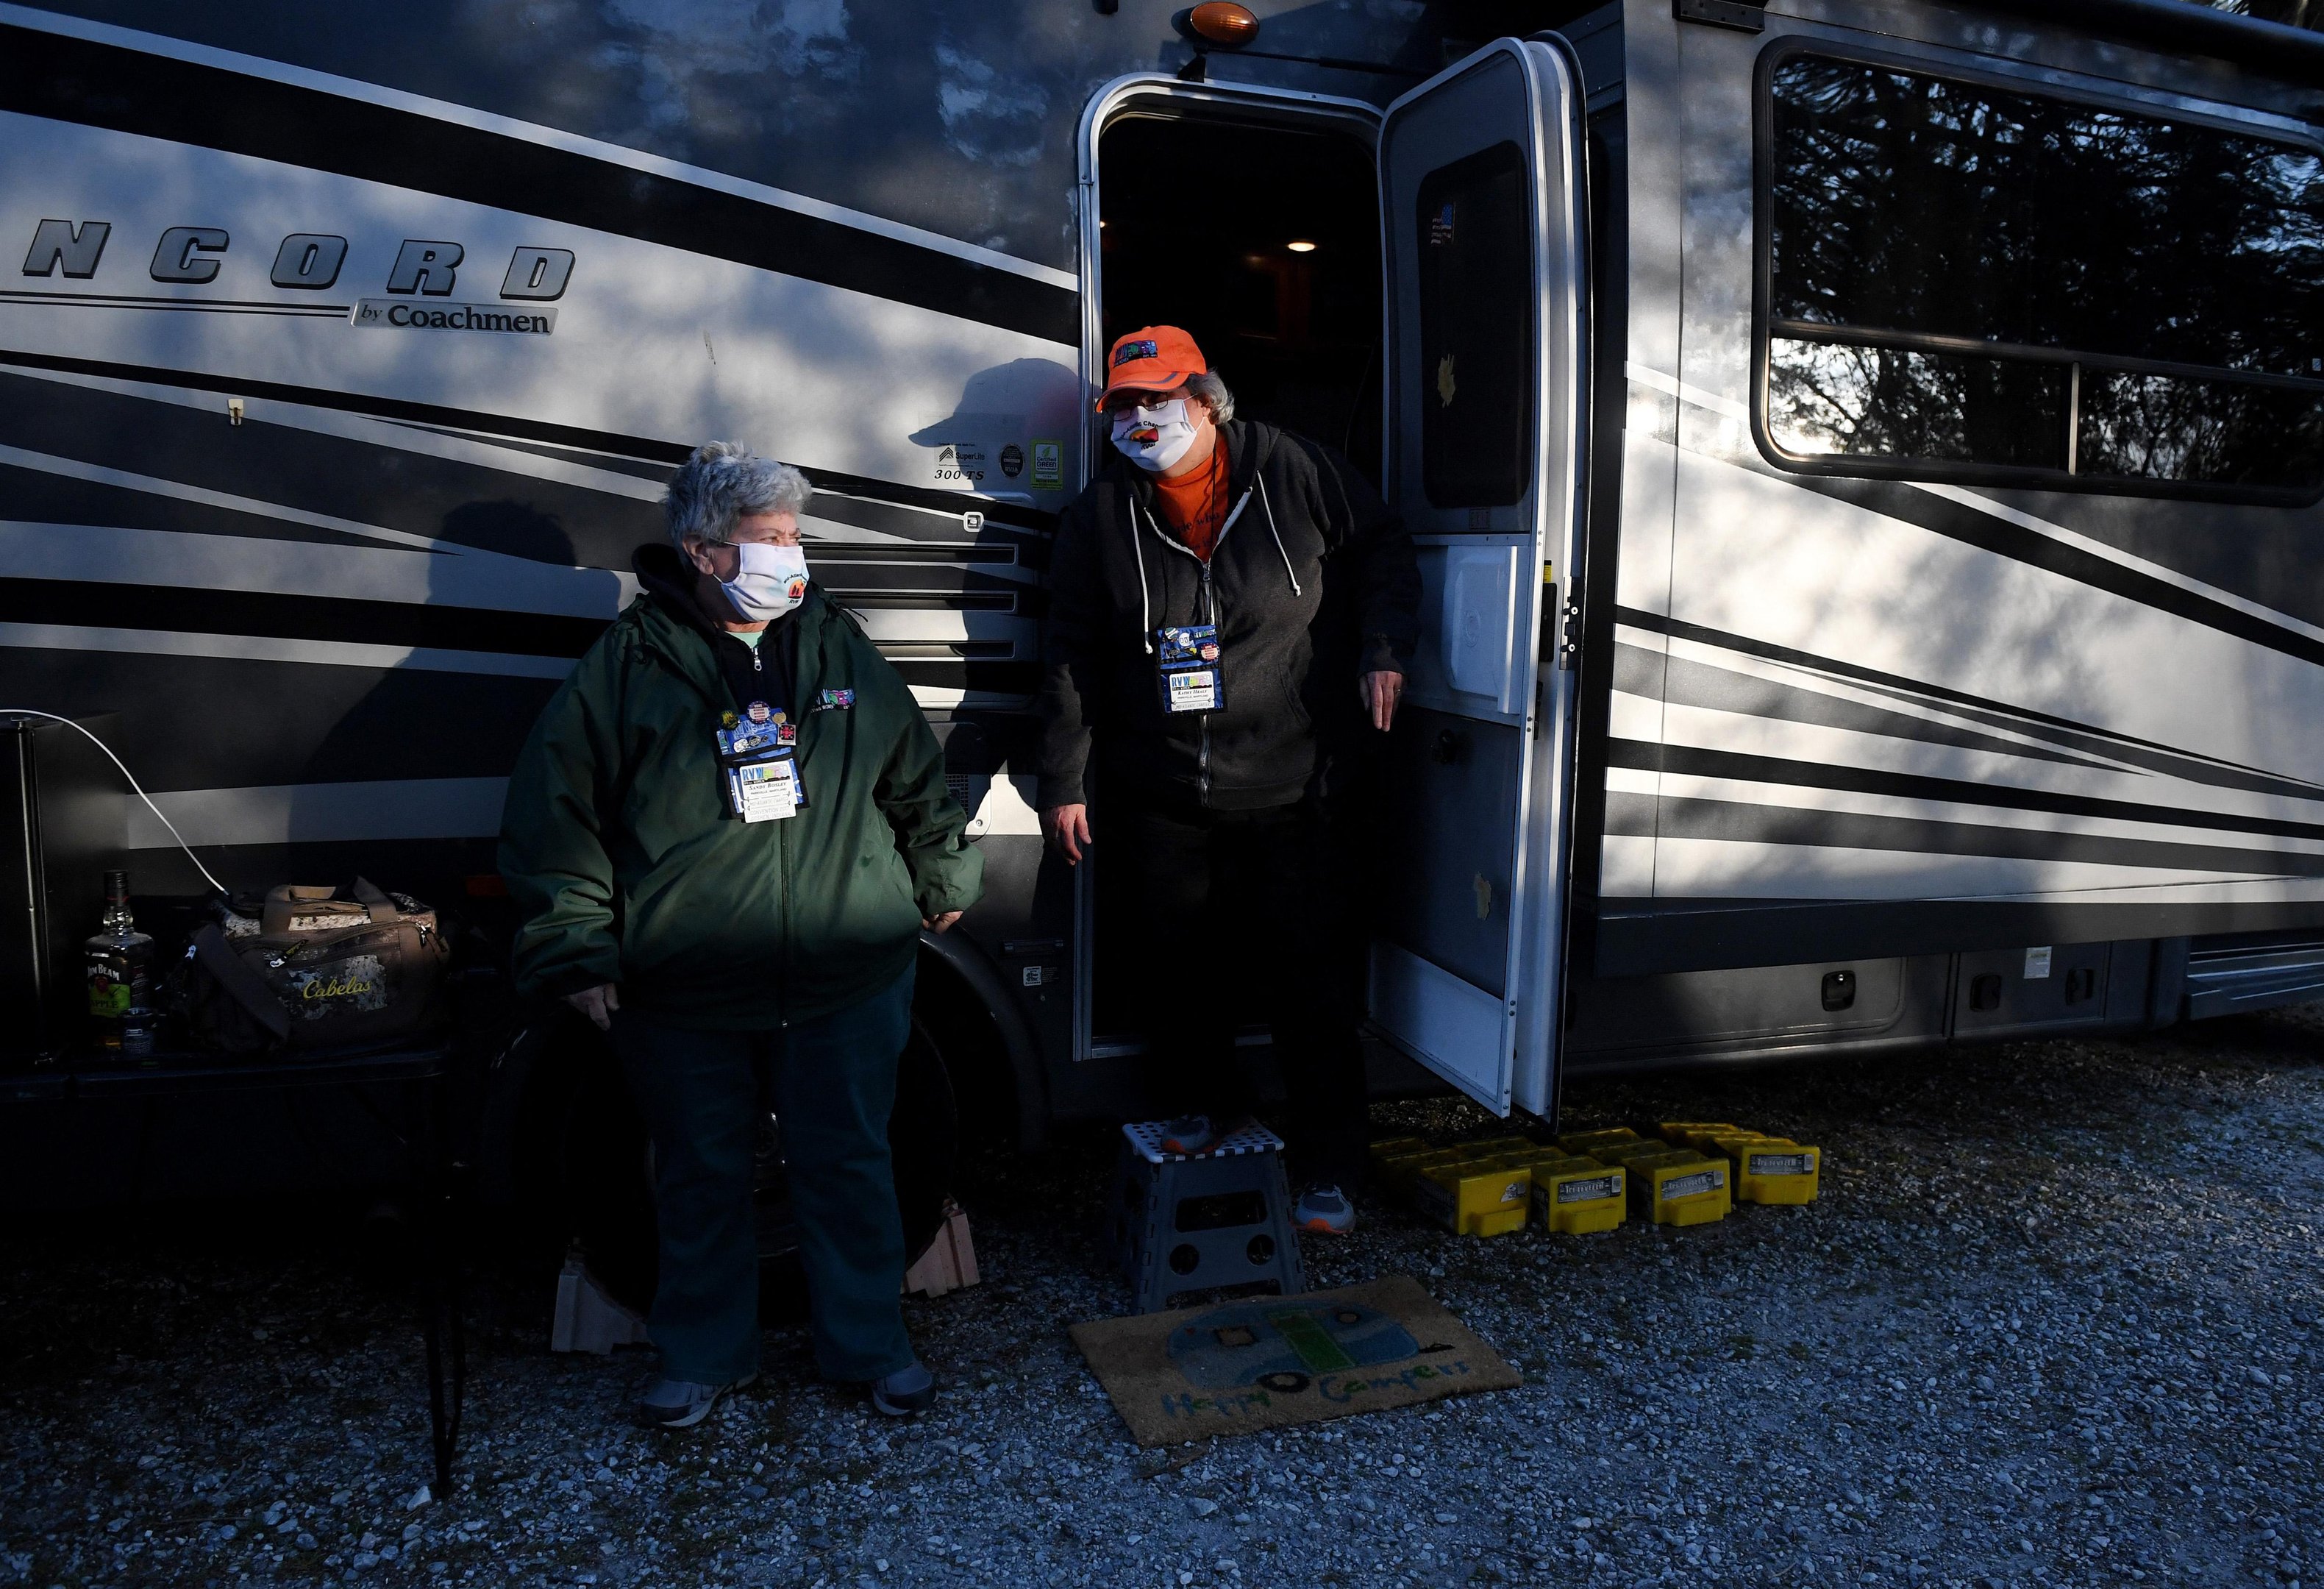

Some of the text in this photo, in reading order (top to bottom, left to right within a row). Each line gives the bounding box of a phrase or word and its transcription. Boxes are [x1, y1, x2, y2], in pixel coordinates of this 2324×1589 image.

[23, 218, 576, 301] NCORD
[360, 303, 551, 334] by Coachmen
[955, 452, 985, 461] SuperLite
[934, 469, 984, 480] 300 TS
[741, 767, 764, 781] RVW
[88, 963, 120, 981] JIM BEAM
[90, 1000, 118, 1009] APPLE
